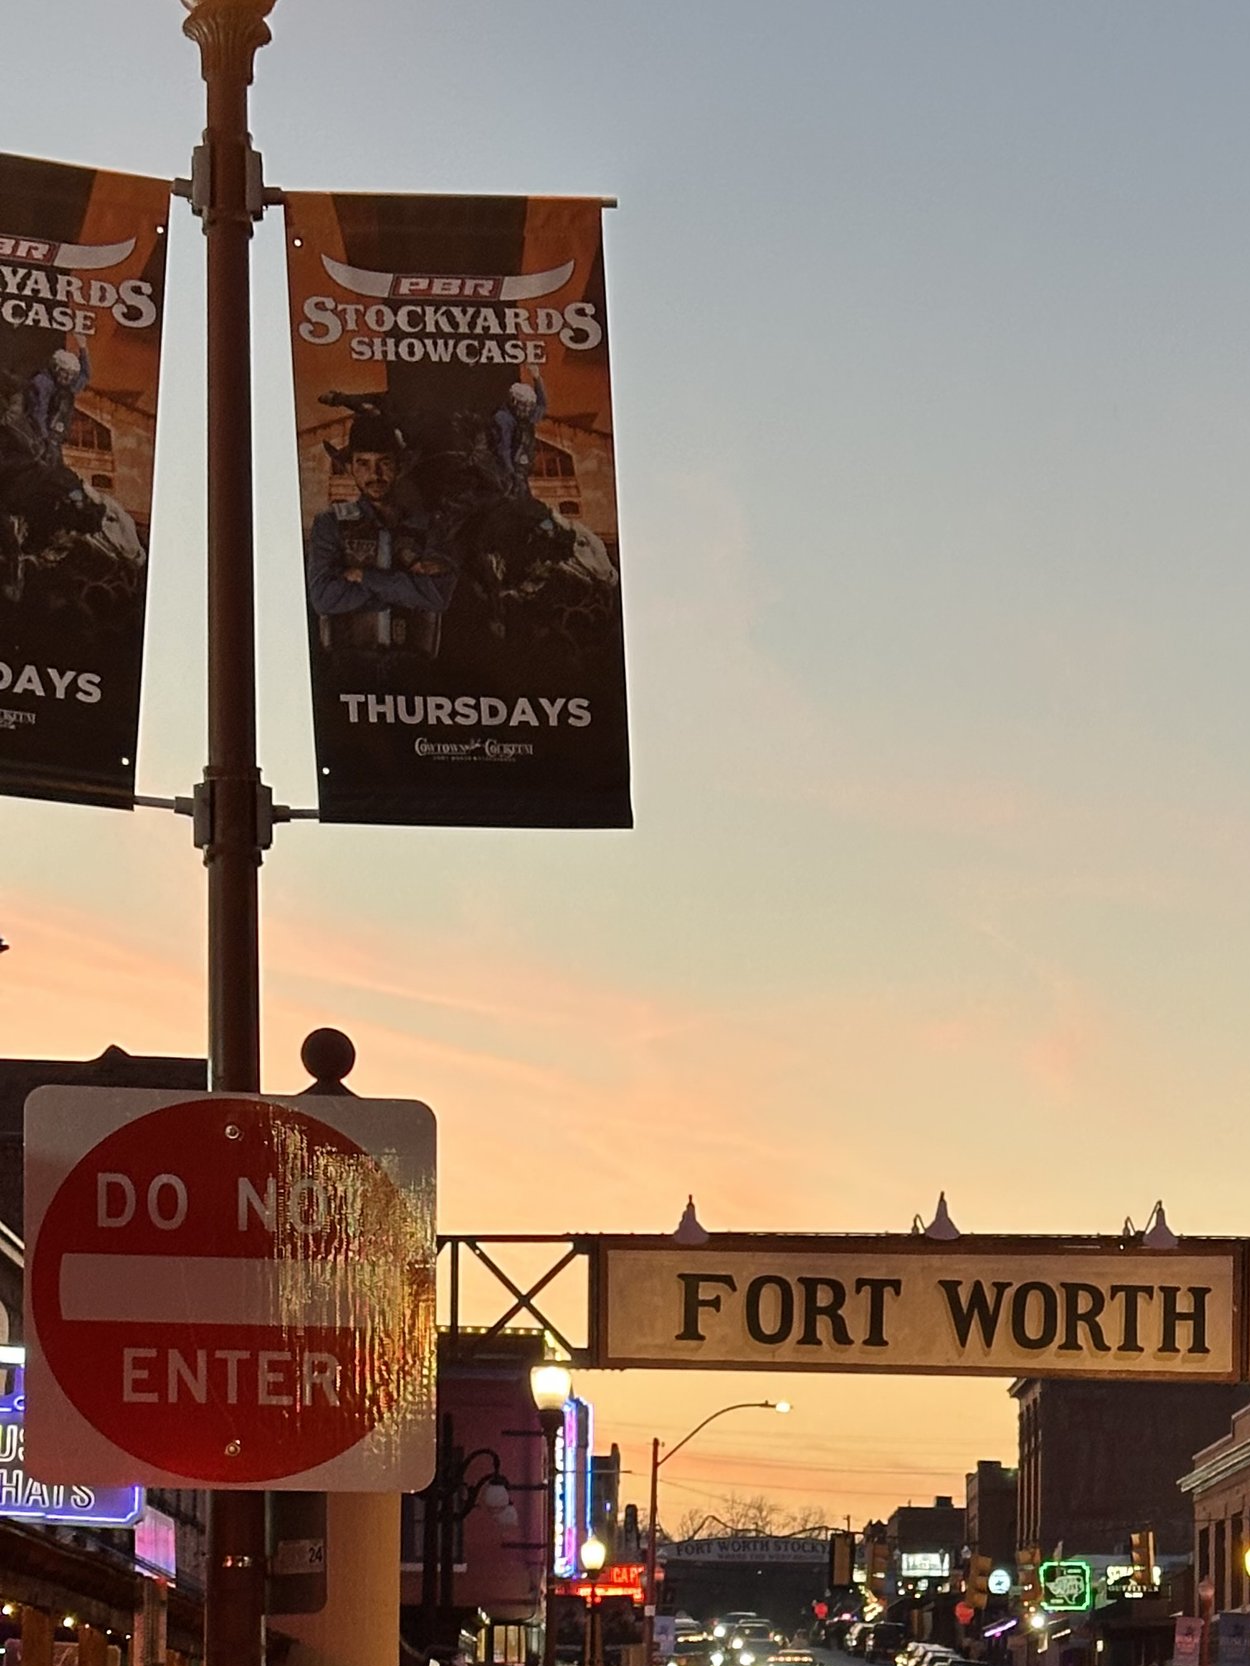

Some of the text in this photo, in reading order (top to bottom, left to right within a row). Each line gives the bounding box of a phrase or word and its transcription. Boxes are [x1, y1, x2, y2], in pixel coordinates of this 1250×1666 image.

[399, 276, 495, 296] PBR
[300, 296, 602, 350] STOCKYARDS
[350, 336, 547, 364] SHOWCASE
[339, 693, 592, 727] THURSDAYS
[96, 1172, 373, 1236] DO NO
[675, 1272, 1212, 1354] FORT WORTH
[122, 1346, 341, 1408] ENTER
[676, 1543, 713, 1556] FORT
[718, 1540, 769, 1553] WORTH
